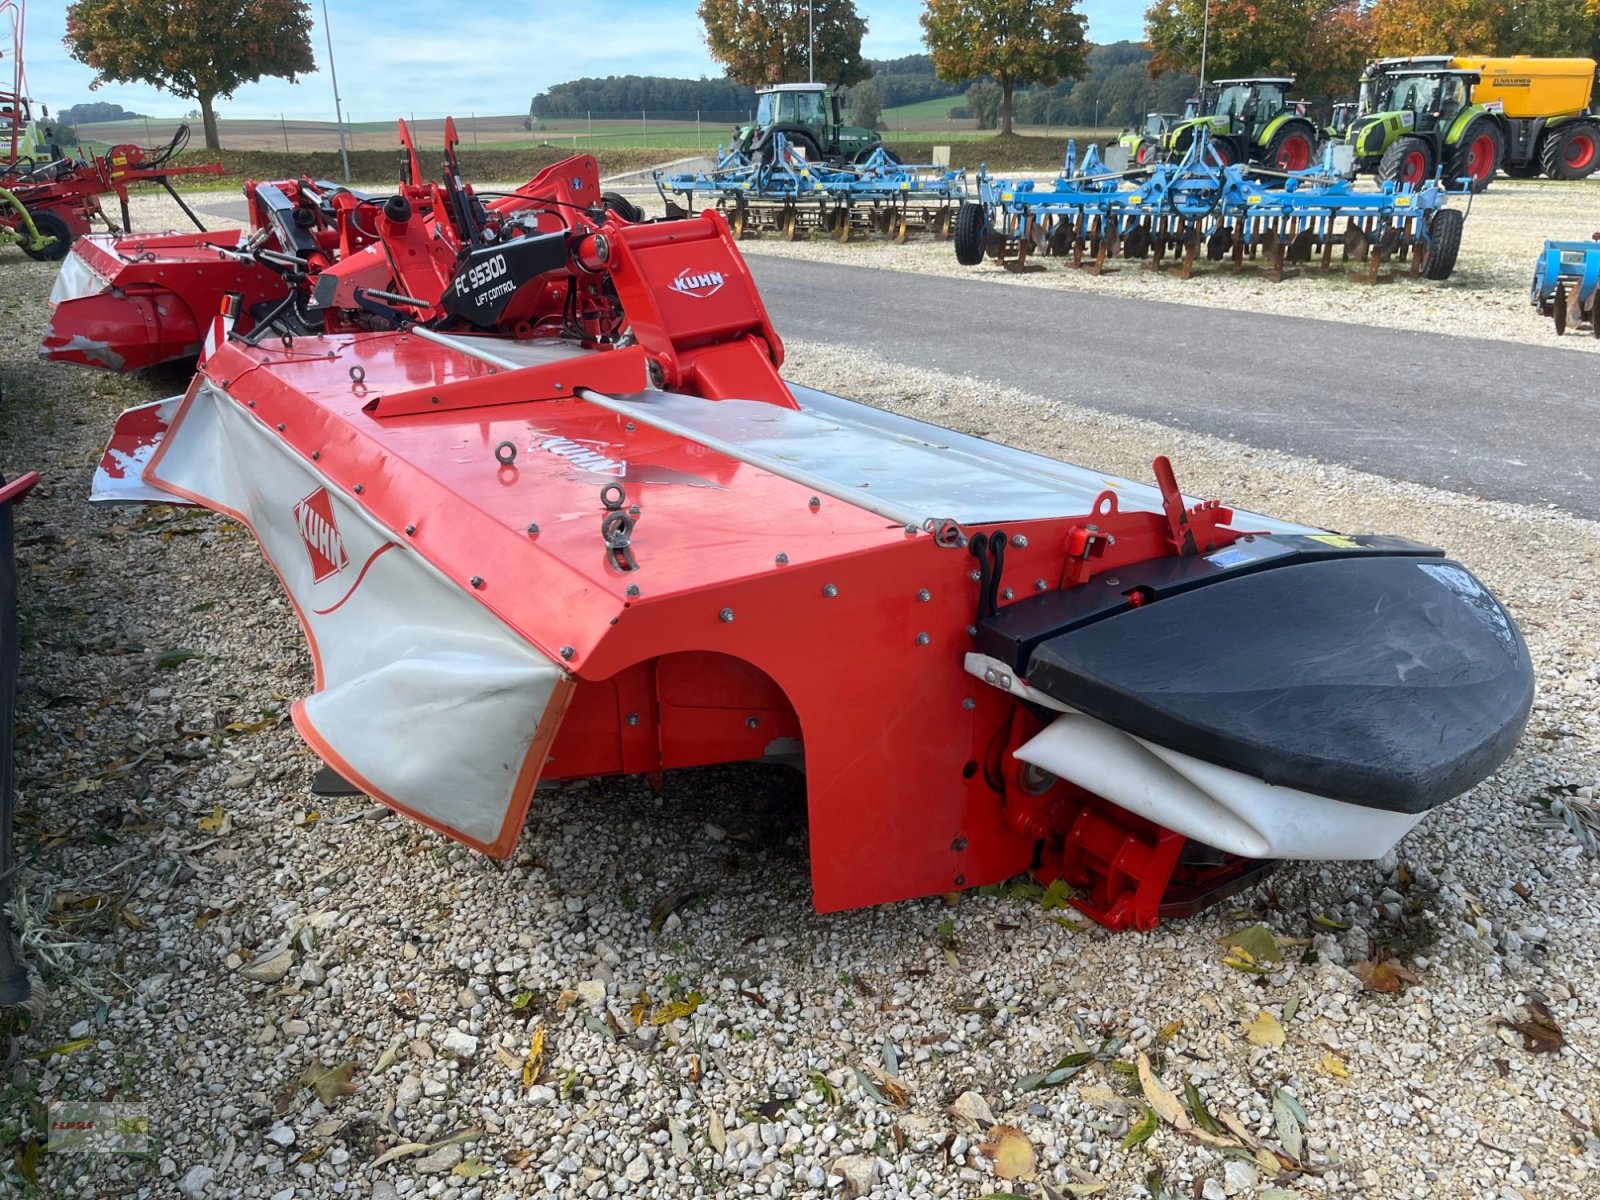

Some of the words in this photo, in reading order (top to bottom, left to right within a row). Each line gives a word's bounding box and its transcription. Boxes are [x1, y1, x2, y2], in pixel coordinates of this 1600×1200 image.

[454, 273, 470, 297] FC
[468, 253, 507, 289] 9530D
[674, 272, 724, 291] KUHN
[475, 292, 489, 307] LIFT
[488, 280, 517, 301] CONTROL
[539, 437, 622, 473] KUHN
[298, 499, 342, 573] KUHN
